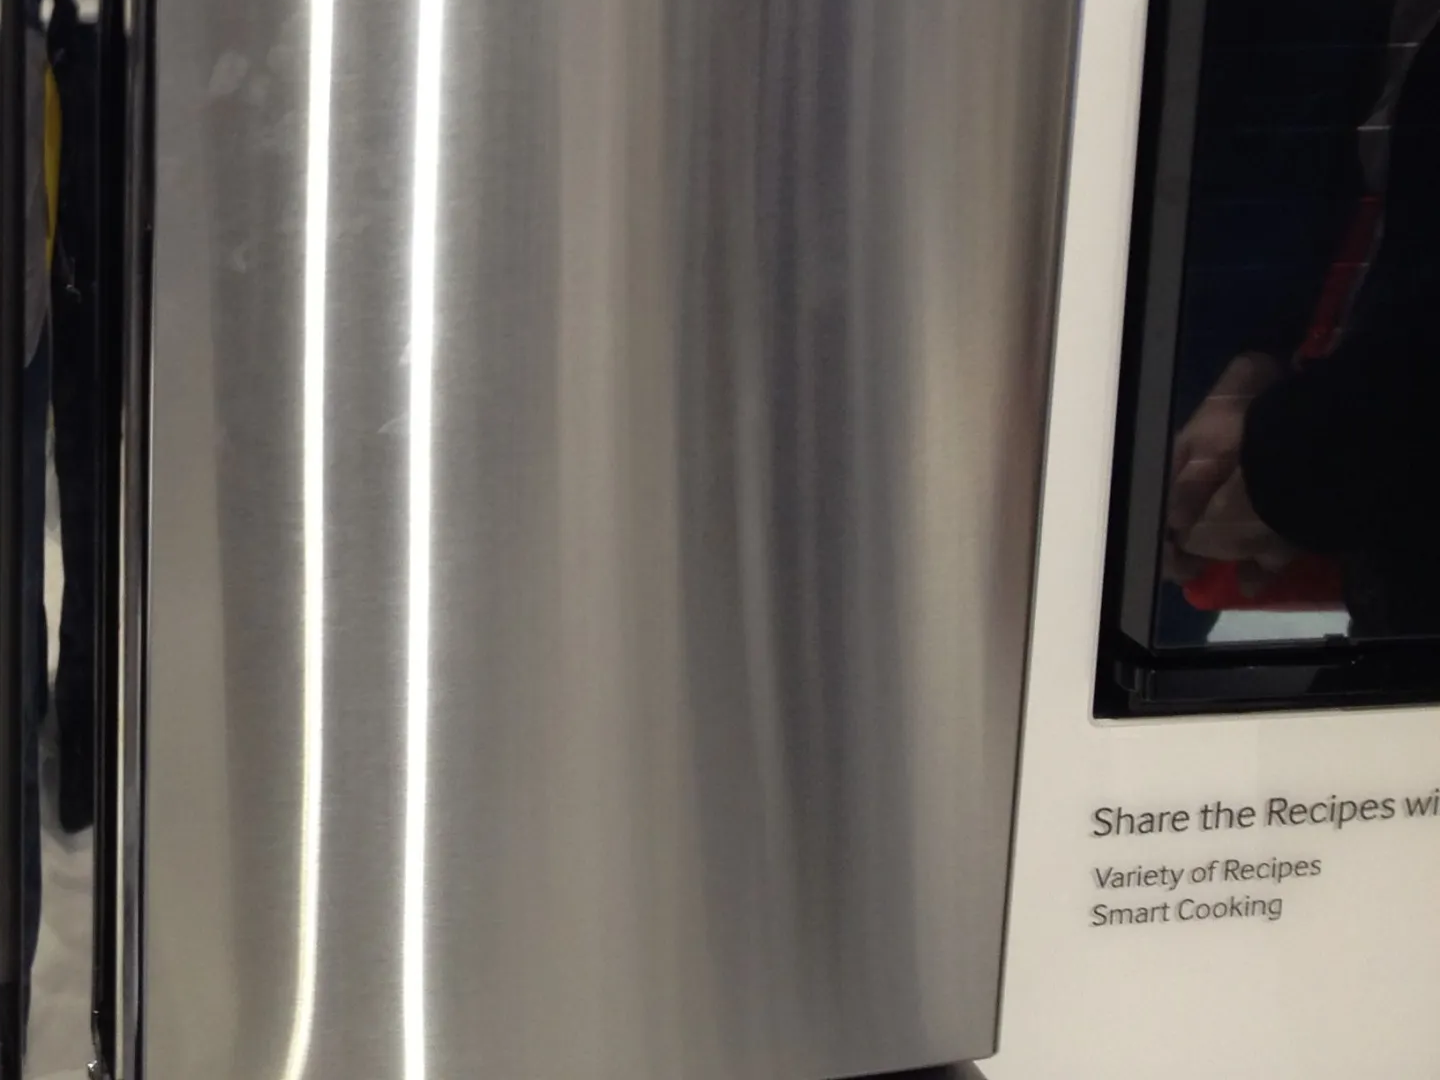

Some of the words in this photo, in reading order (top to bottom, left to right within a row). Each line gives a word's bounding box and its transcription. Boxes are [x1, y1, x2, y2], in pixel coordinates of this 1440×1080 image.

[1092, 806, 1191, 837] Share
[1200, 801, 1256, 831] the
[1267, 795, 1396, 829] Recipes
[1405, 788, 1440, 817] wi
[1095, 865, 1185, 891] Variety
[1190, 860, 1220, 884] of
[1223, 857, 1323, 883] Recipes
[1091, 902, 1170, 927] Smart
[1178, 895, 1283, 922] Cooking
